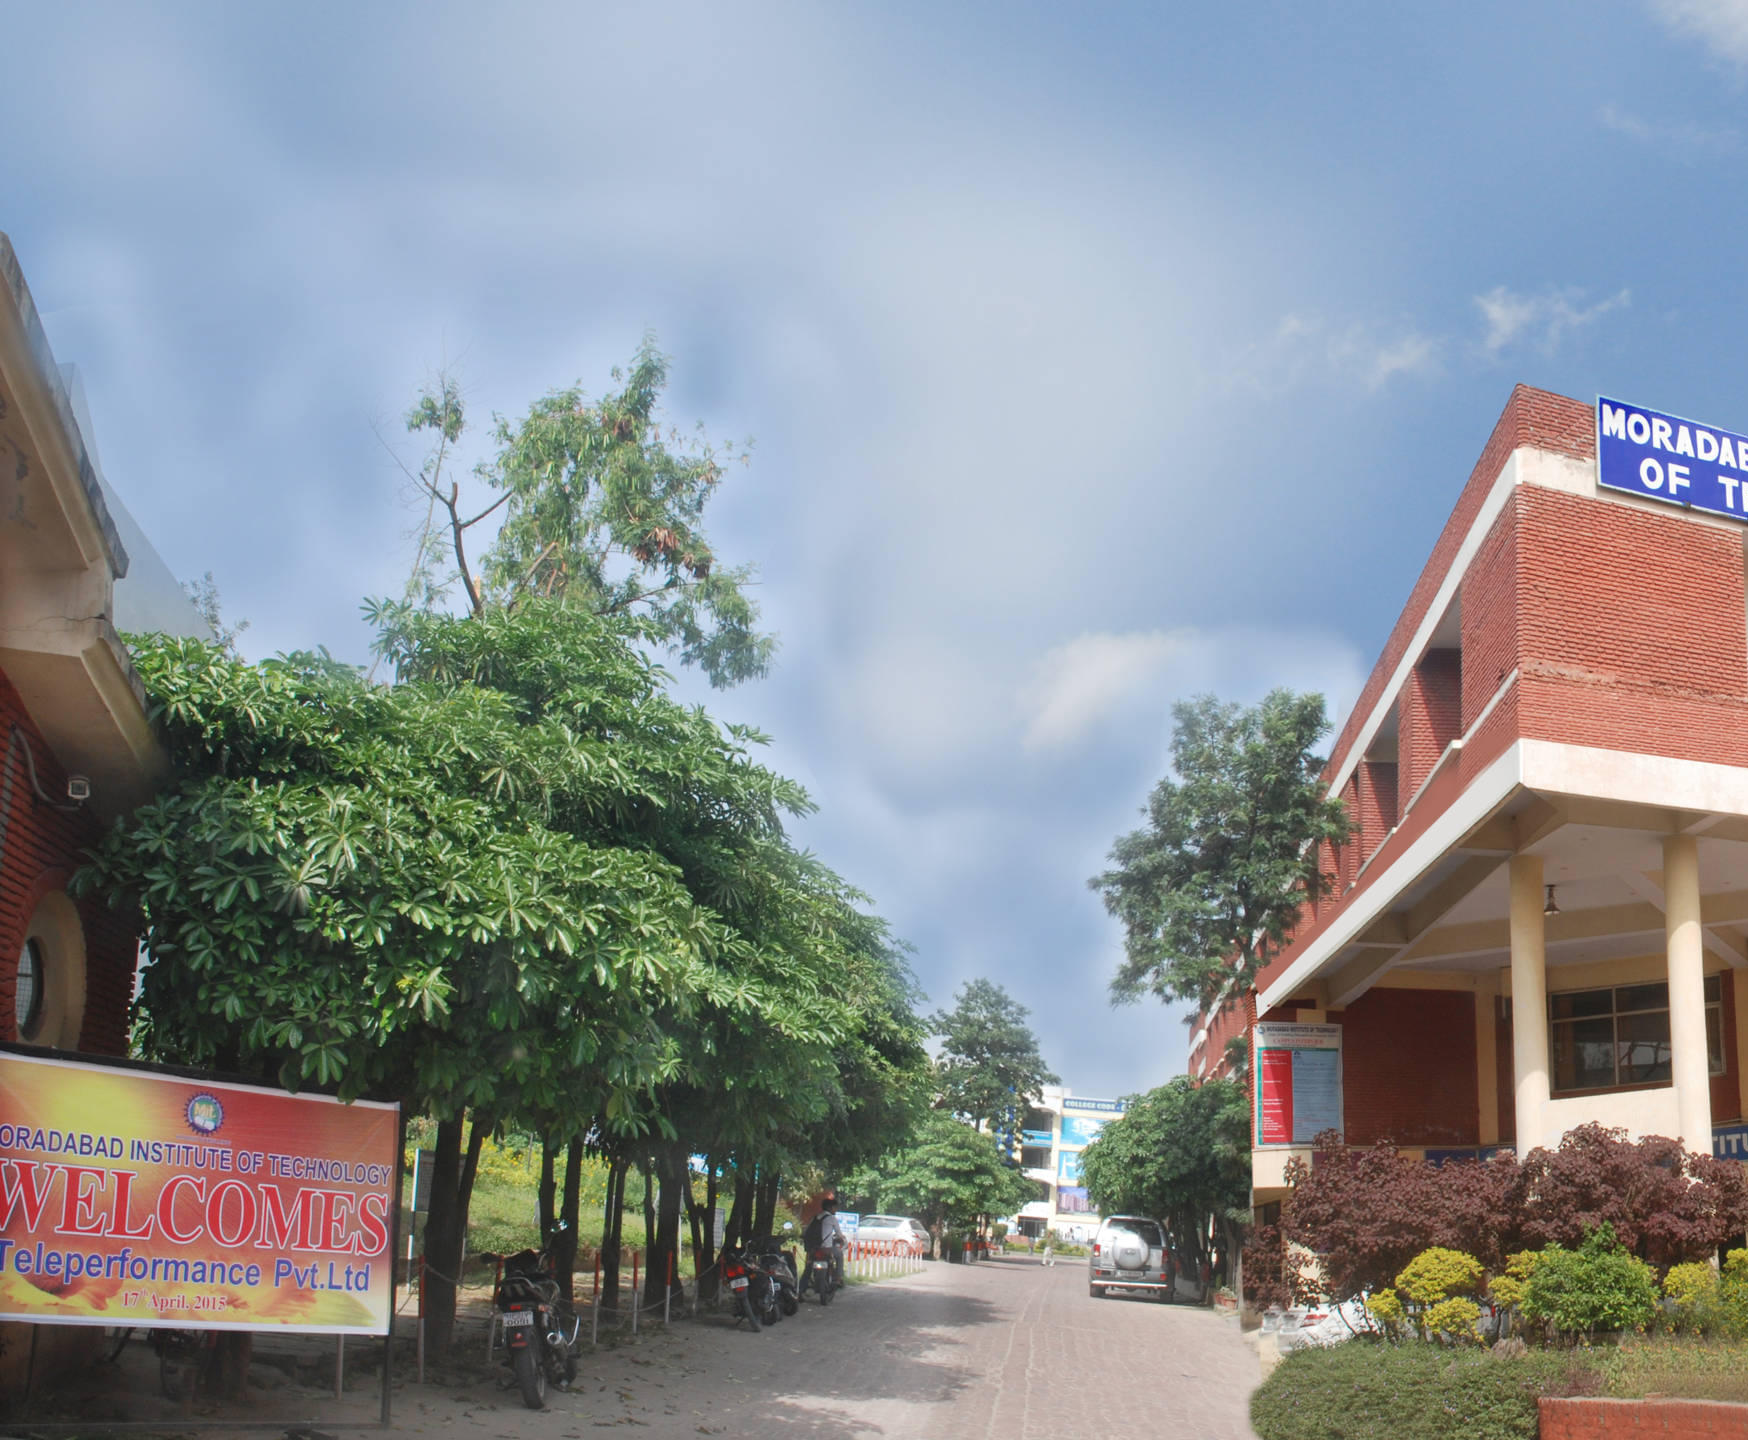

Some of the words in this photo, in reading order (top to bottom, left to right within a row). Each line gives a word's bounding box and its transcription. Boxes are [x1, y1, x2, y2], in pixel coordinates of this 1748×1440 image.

[1640, 458, 1690, 495] OF
[130, 1139, 232, 1171] INSTITUTE
[237, 1150, 264, 1174] OF
[268, 1153, 392, 1187] TECHNOLOGY
[0, 1158, 389, 1257] WELCOMES
[274, 1258, 370, 1292] Pvt.Ltd
[192, 1295, 227, 1311] 2015
